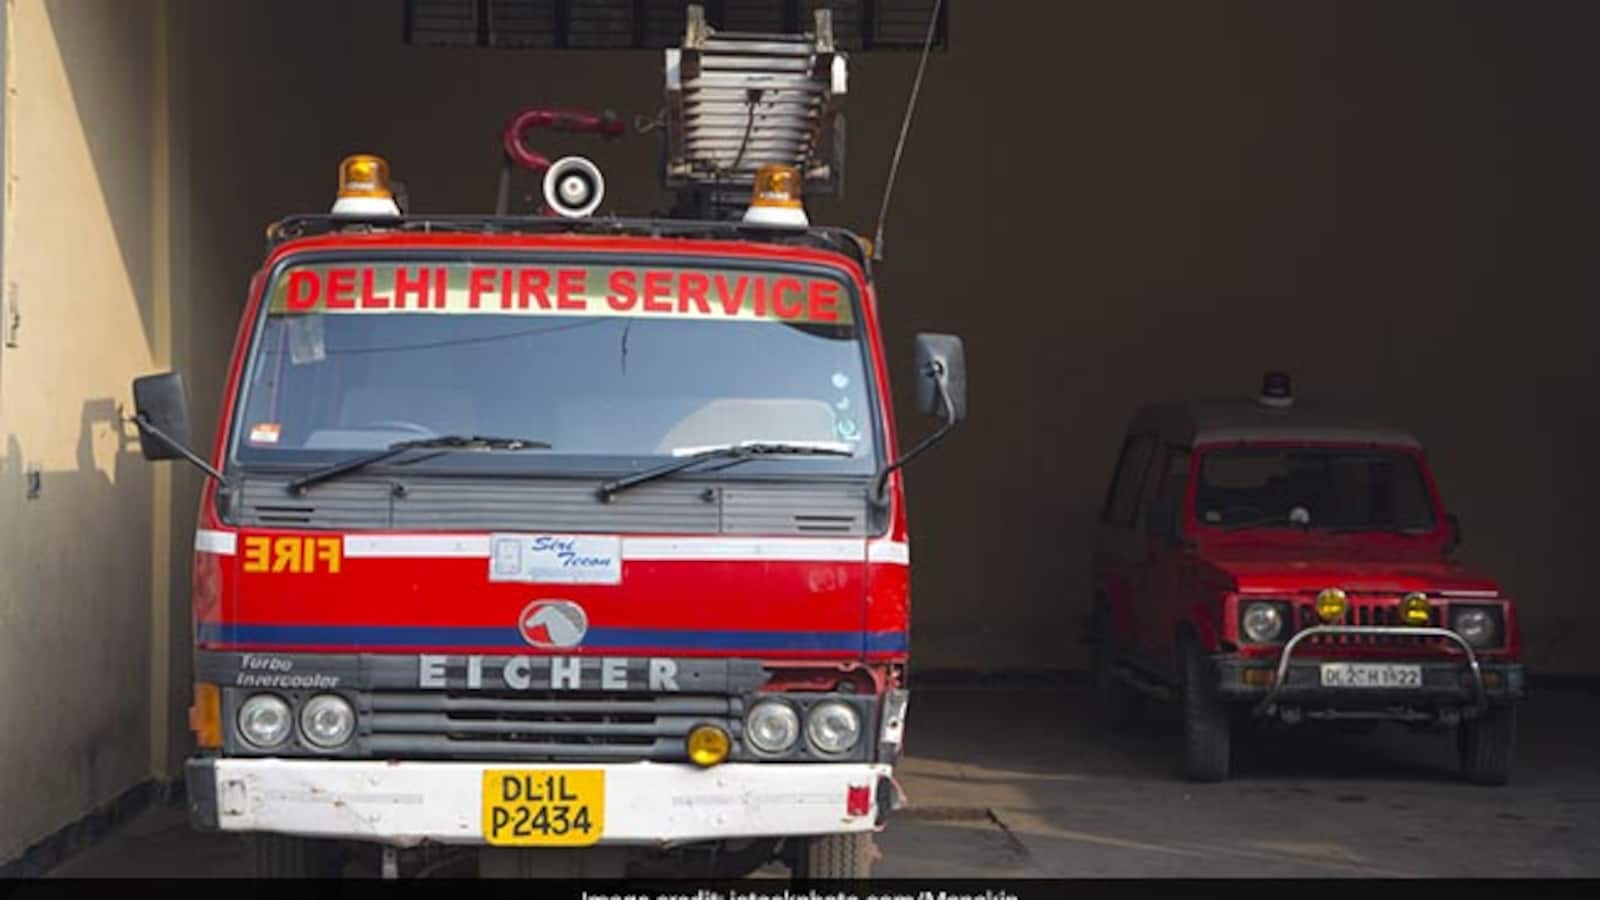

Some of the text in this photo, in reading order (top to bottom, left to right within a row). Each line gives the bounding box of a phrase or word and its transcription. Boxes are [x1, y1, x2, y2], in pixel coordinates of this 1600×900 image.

[285, 266, 840, 322] DELHI FIRE SERVICE
[241, 655, 293, 672] Turbo
[419, 655, 680, 691] EICHER
